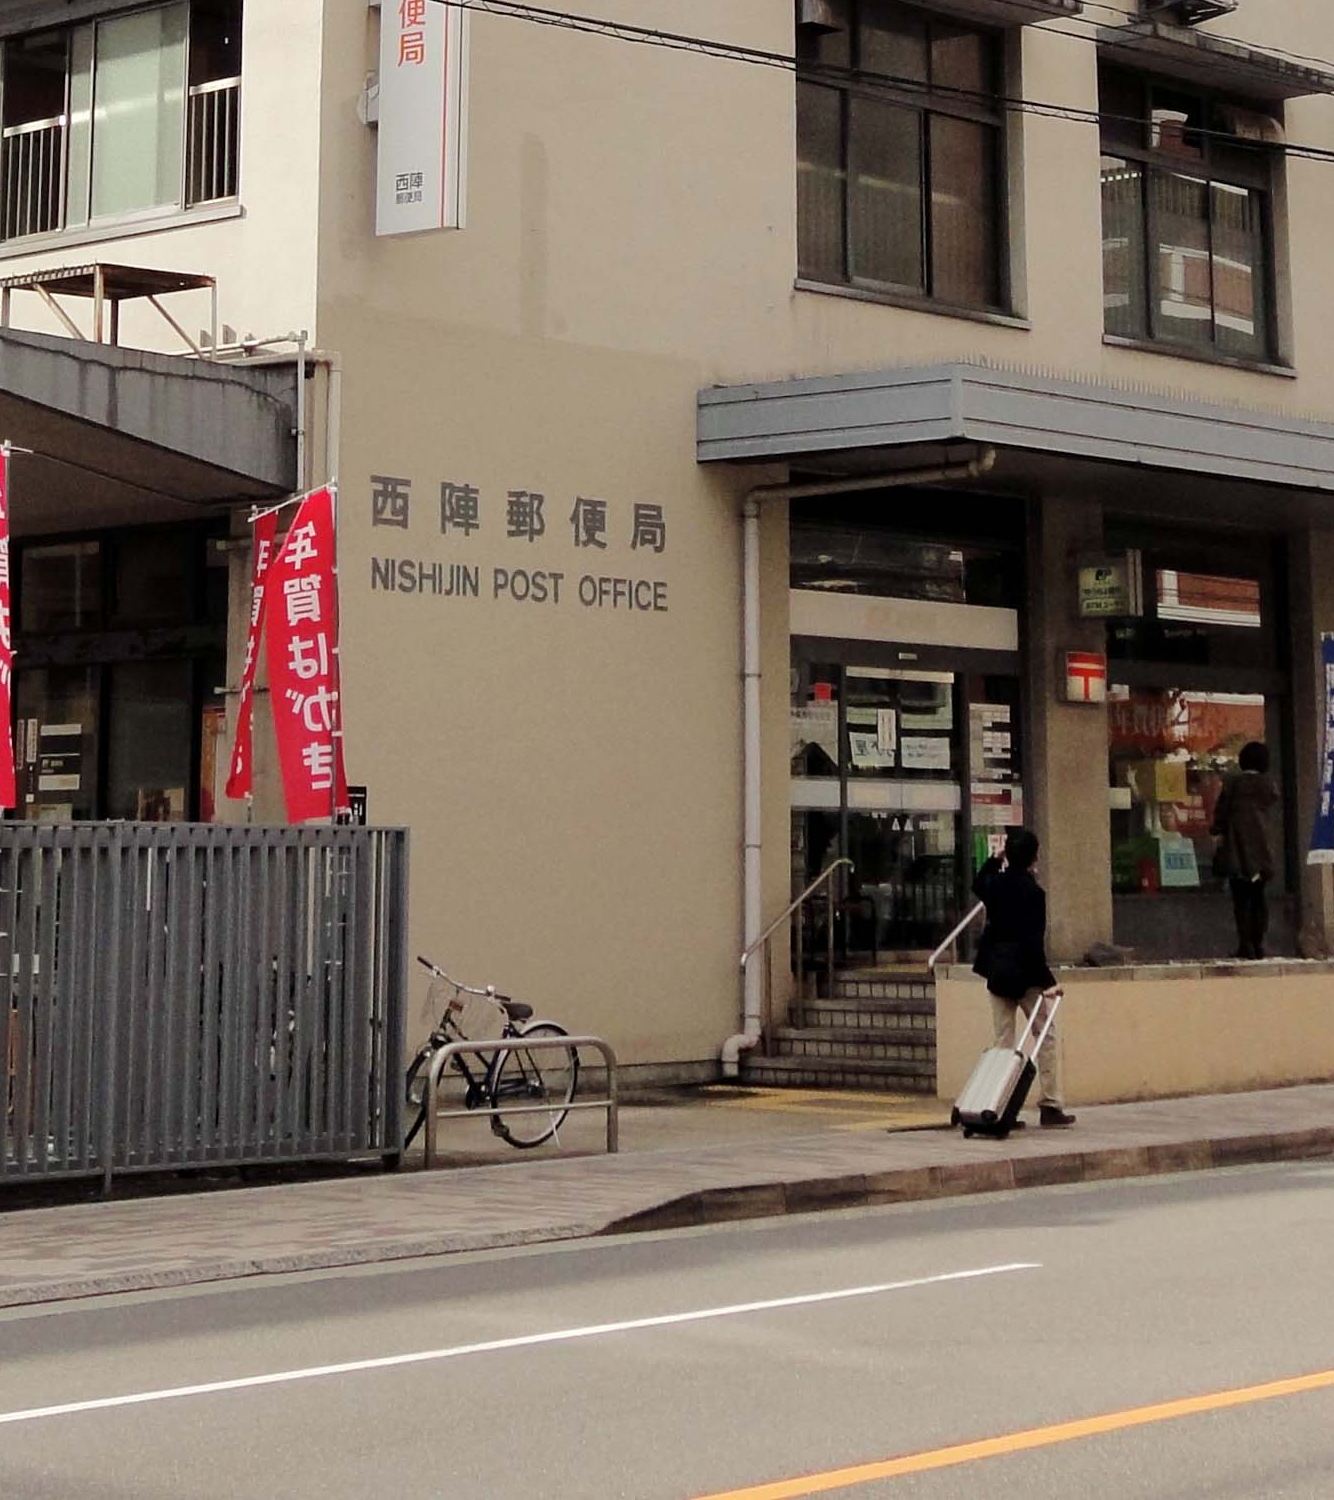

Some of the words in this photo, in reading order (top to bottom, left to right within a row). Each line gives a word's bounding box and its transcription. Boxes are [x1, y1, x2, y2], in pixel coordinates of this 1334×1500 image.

[370, 475, 666, 553] 西陣郵便局
[370, 556, 480, 598] NISHIJIN
[493, 567, 564, 604] POST
[578, 574, 669, 612] OFFICE
